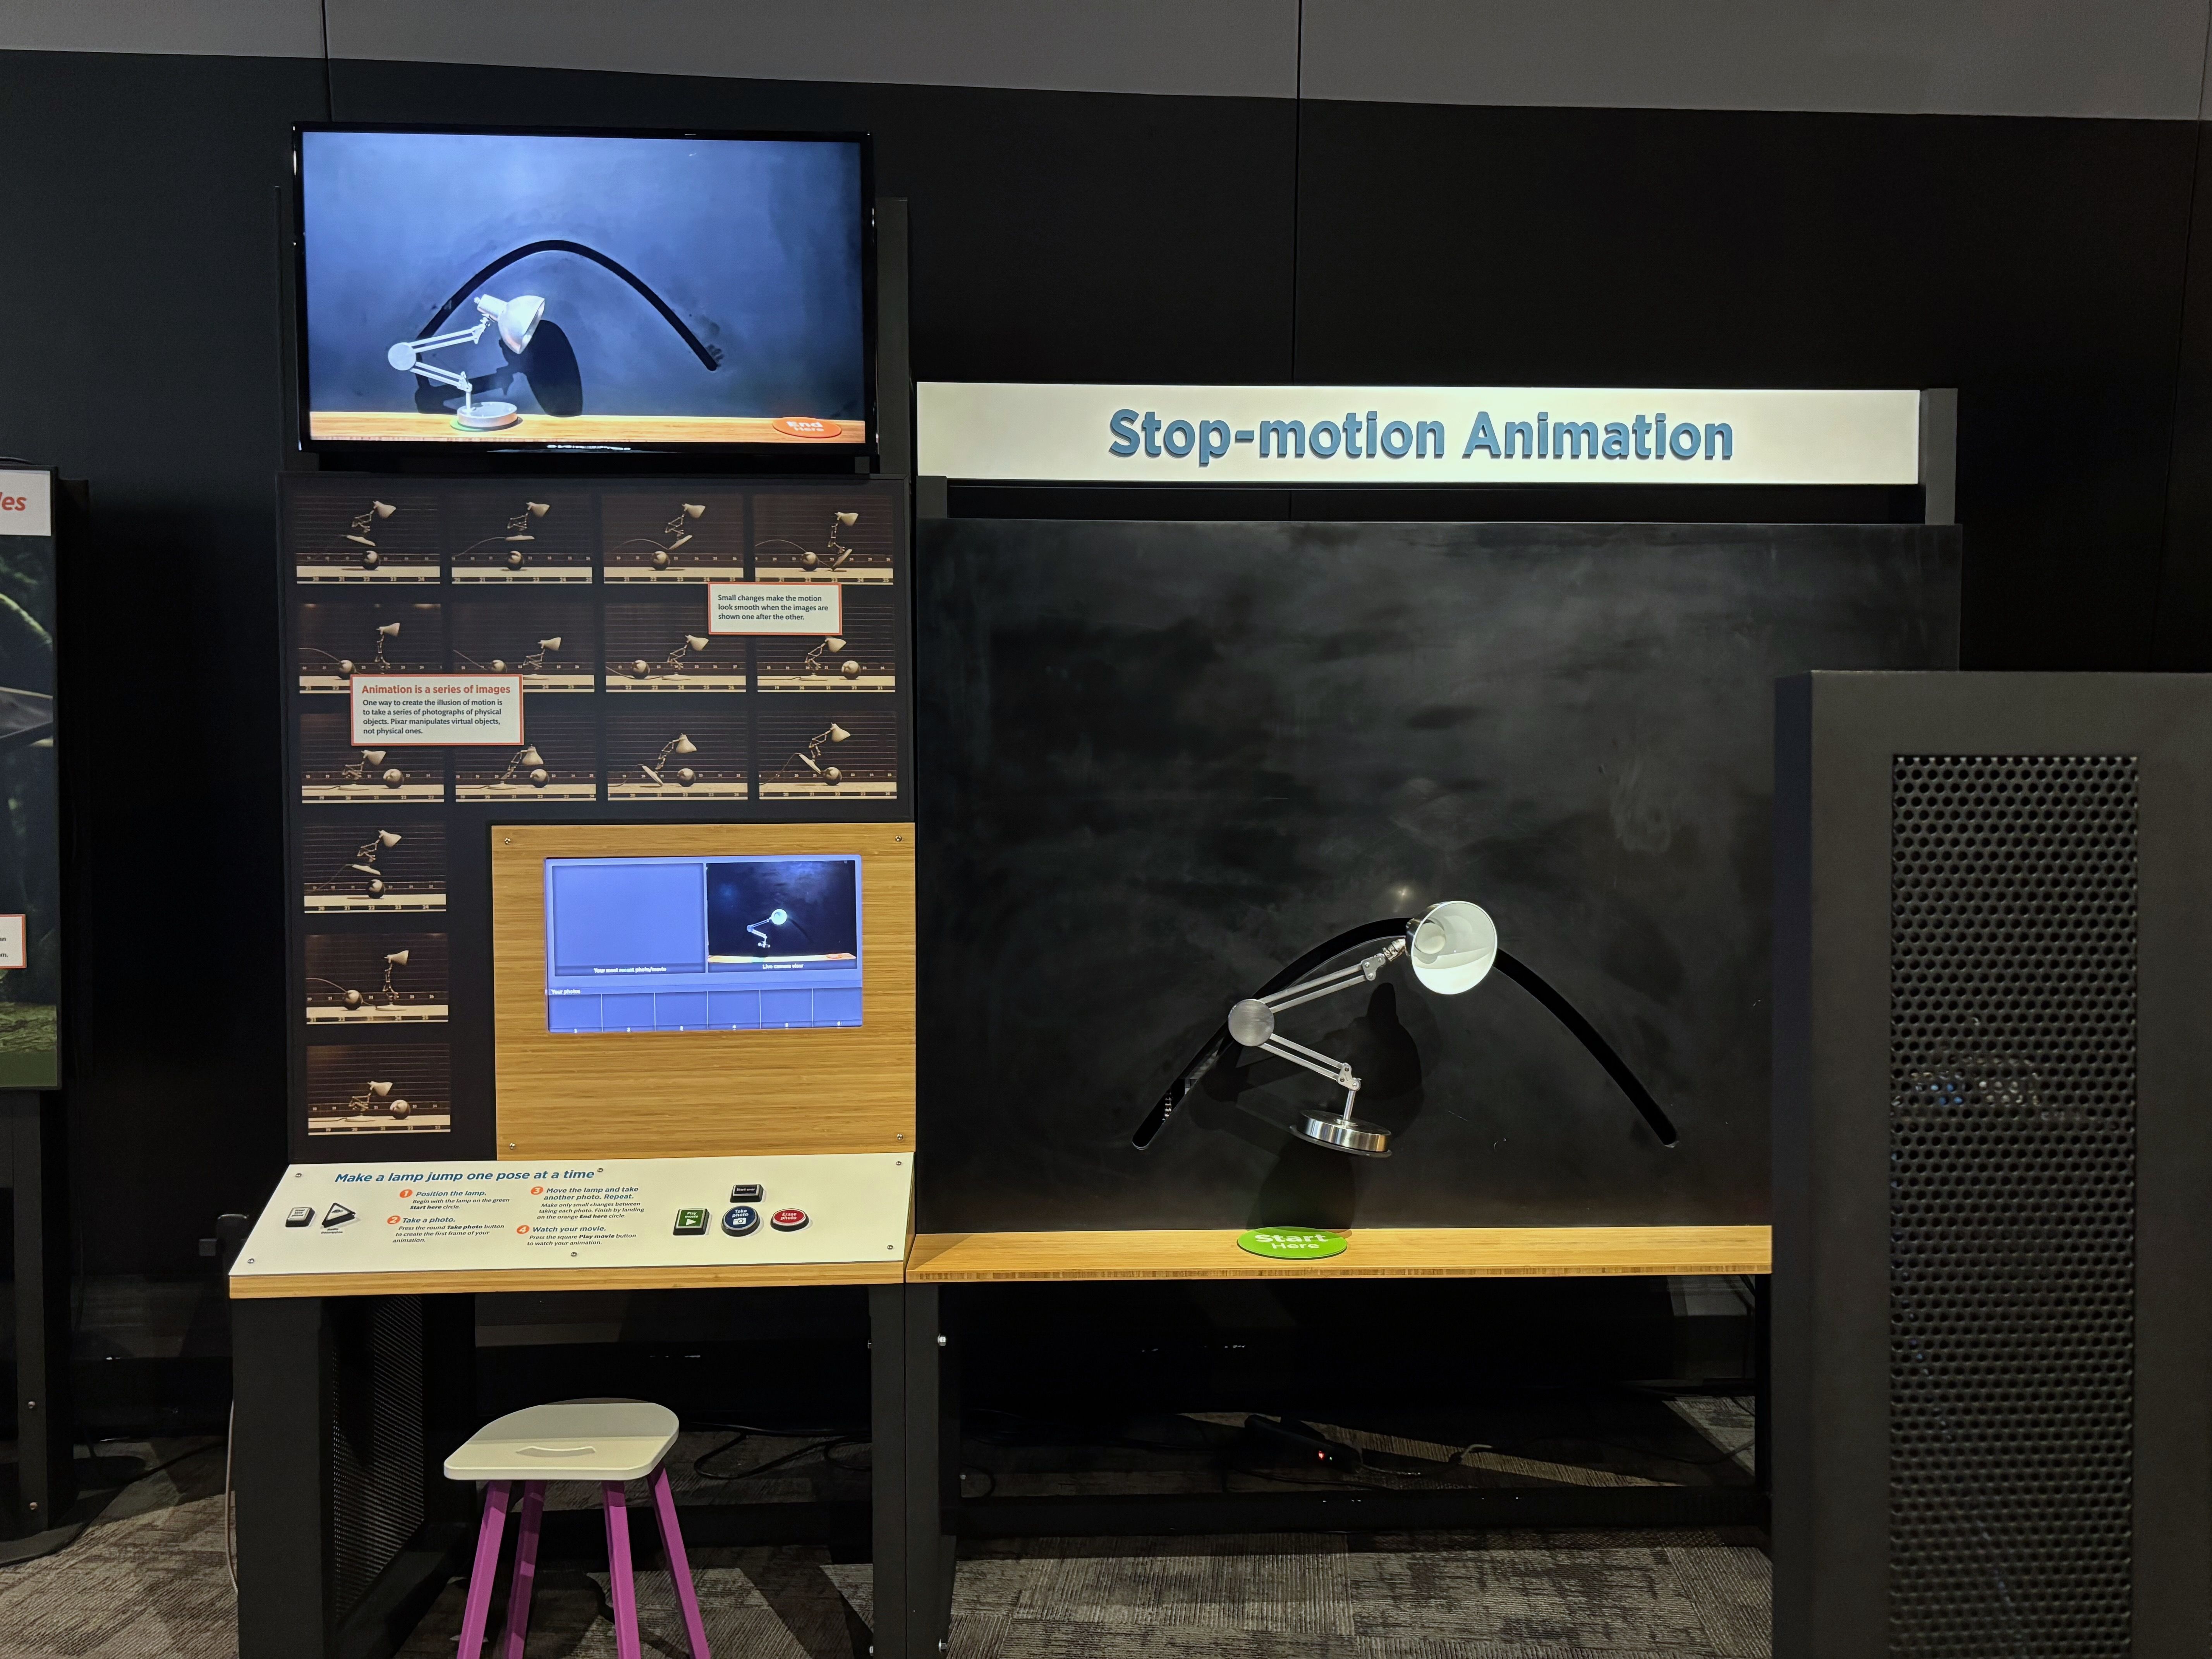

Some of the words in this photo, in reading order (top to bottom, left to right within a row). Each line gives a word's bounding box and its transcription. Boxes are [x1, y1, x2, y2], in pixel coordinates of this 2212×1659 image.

[1108, 409, 1444, 467] Stop-motion
[1462, 411, 1732, 460] Animation
[362, 685, 412, 694] Animation
[415, 685, 422, 693] is
[433, 685, 461, 693] series
[463, 685, 473, 693] of
[476, 685, 510, 694] images
[376, 727, 403, 735] physical
[335, 1173, 372, 1182] Make
[388, 1173, 423, 1182] lamp
[425, 1172, 463, 1182] jump
[496, 1173, 530, 1181] pose
[563, 1170, 594, 1178] time
[1254, 1234, 1329, 1242] Start
